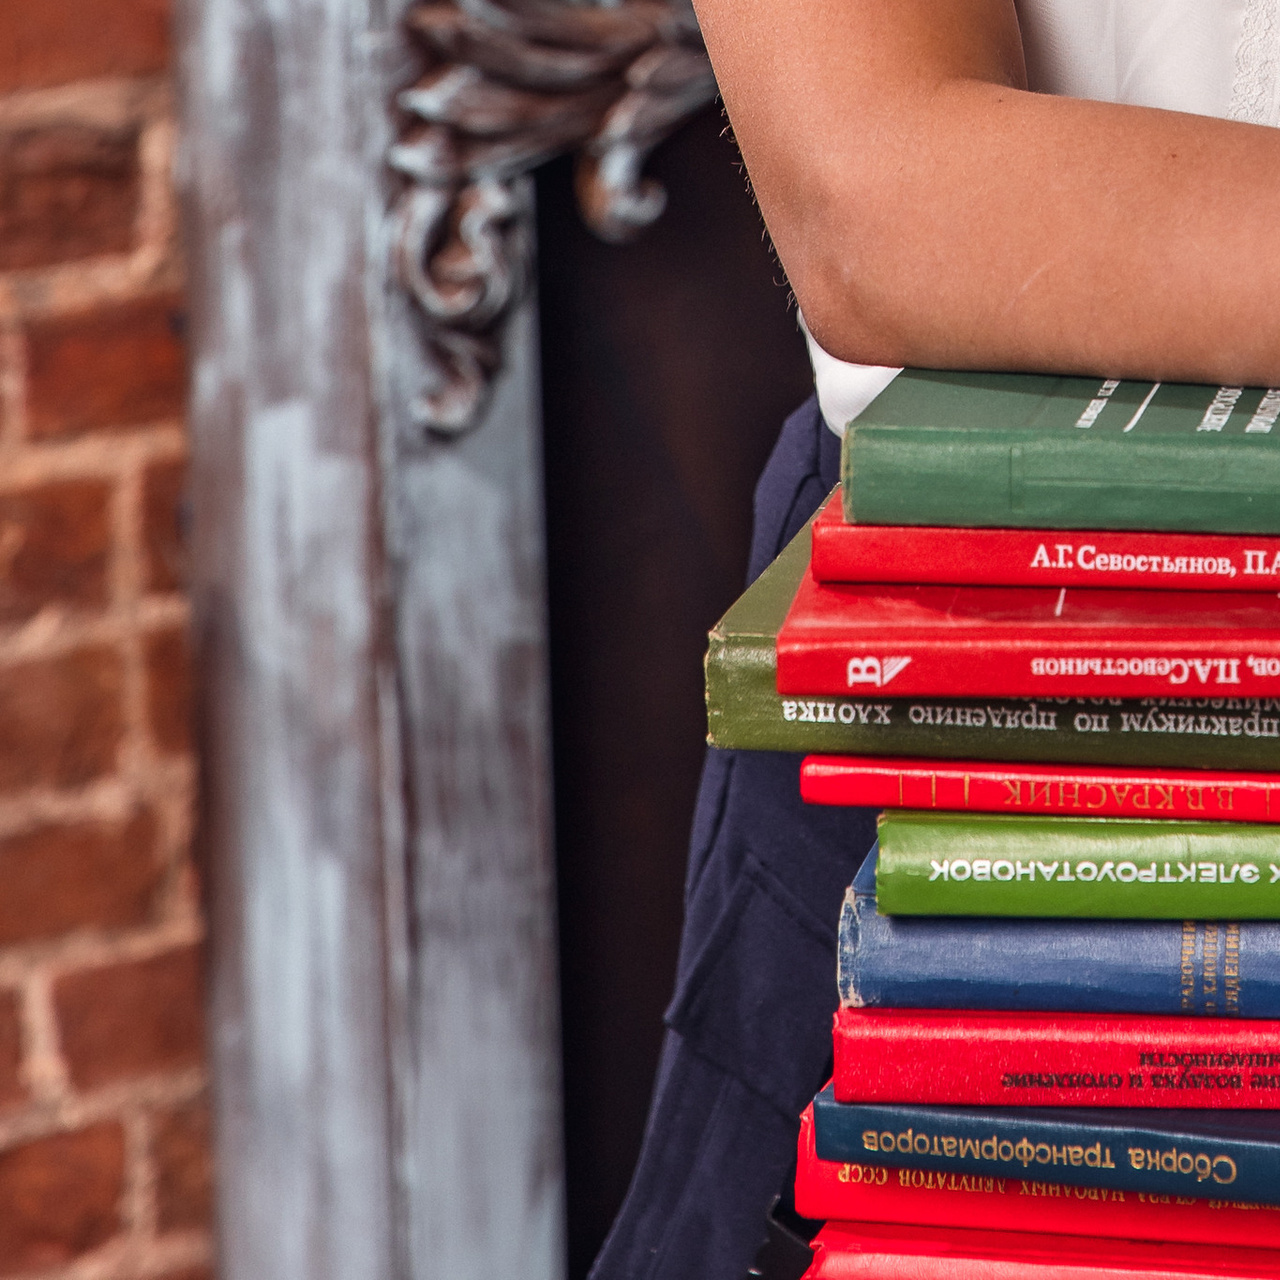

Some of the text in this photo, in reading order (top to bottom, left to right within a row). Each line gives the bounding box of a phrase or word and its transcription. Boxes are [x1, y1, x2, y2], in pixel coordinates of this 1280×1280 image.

[782, 700, 892, 725] хлопка
[908, 704, 1057, 732] прядению
[1073, 713, 1109, 732] по
[1120, 706, 1280, 738] практикум
[1003, 780, 1235, 811] В.В.КРАСНИК
[929, 859, 1260, 884] ЭЛЕКТРОУСТАНОВОК
[1000, 1072, 1123, 1089] отопление
[1129, 1073, 1143, 1089] и
[1151, 1067, 1244, 1090] воздуха
[862, 1128, 1237, 1184] Сборка трансформаторов
[838, 1163, 889, 1185] СССР
